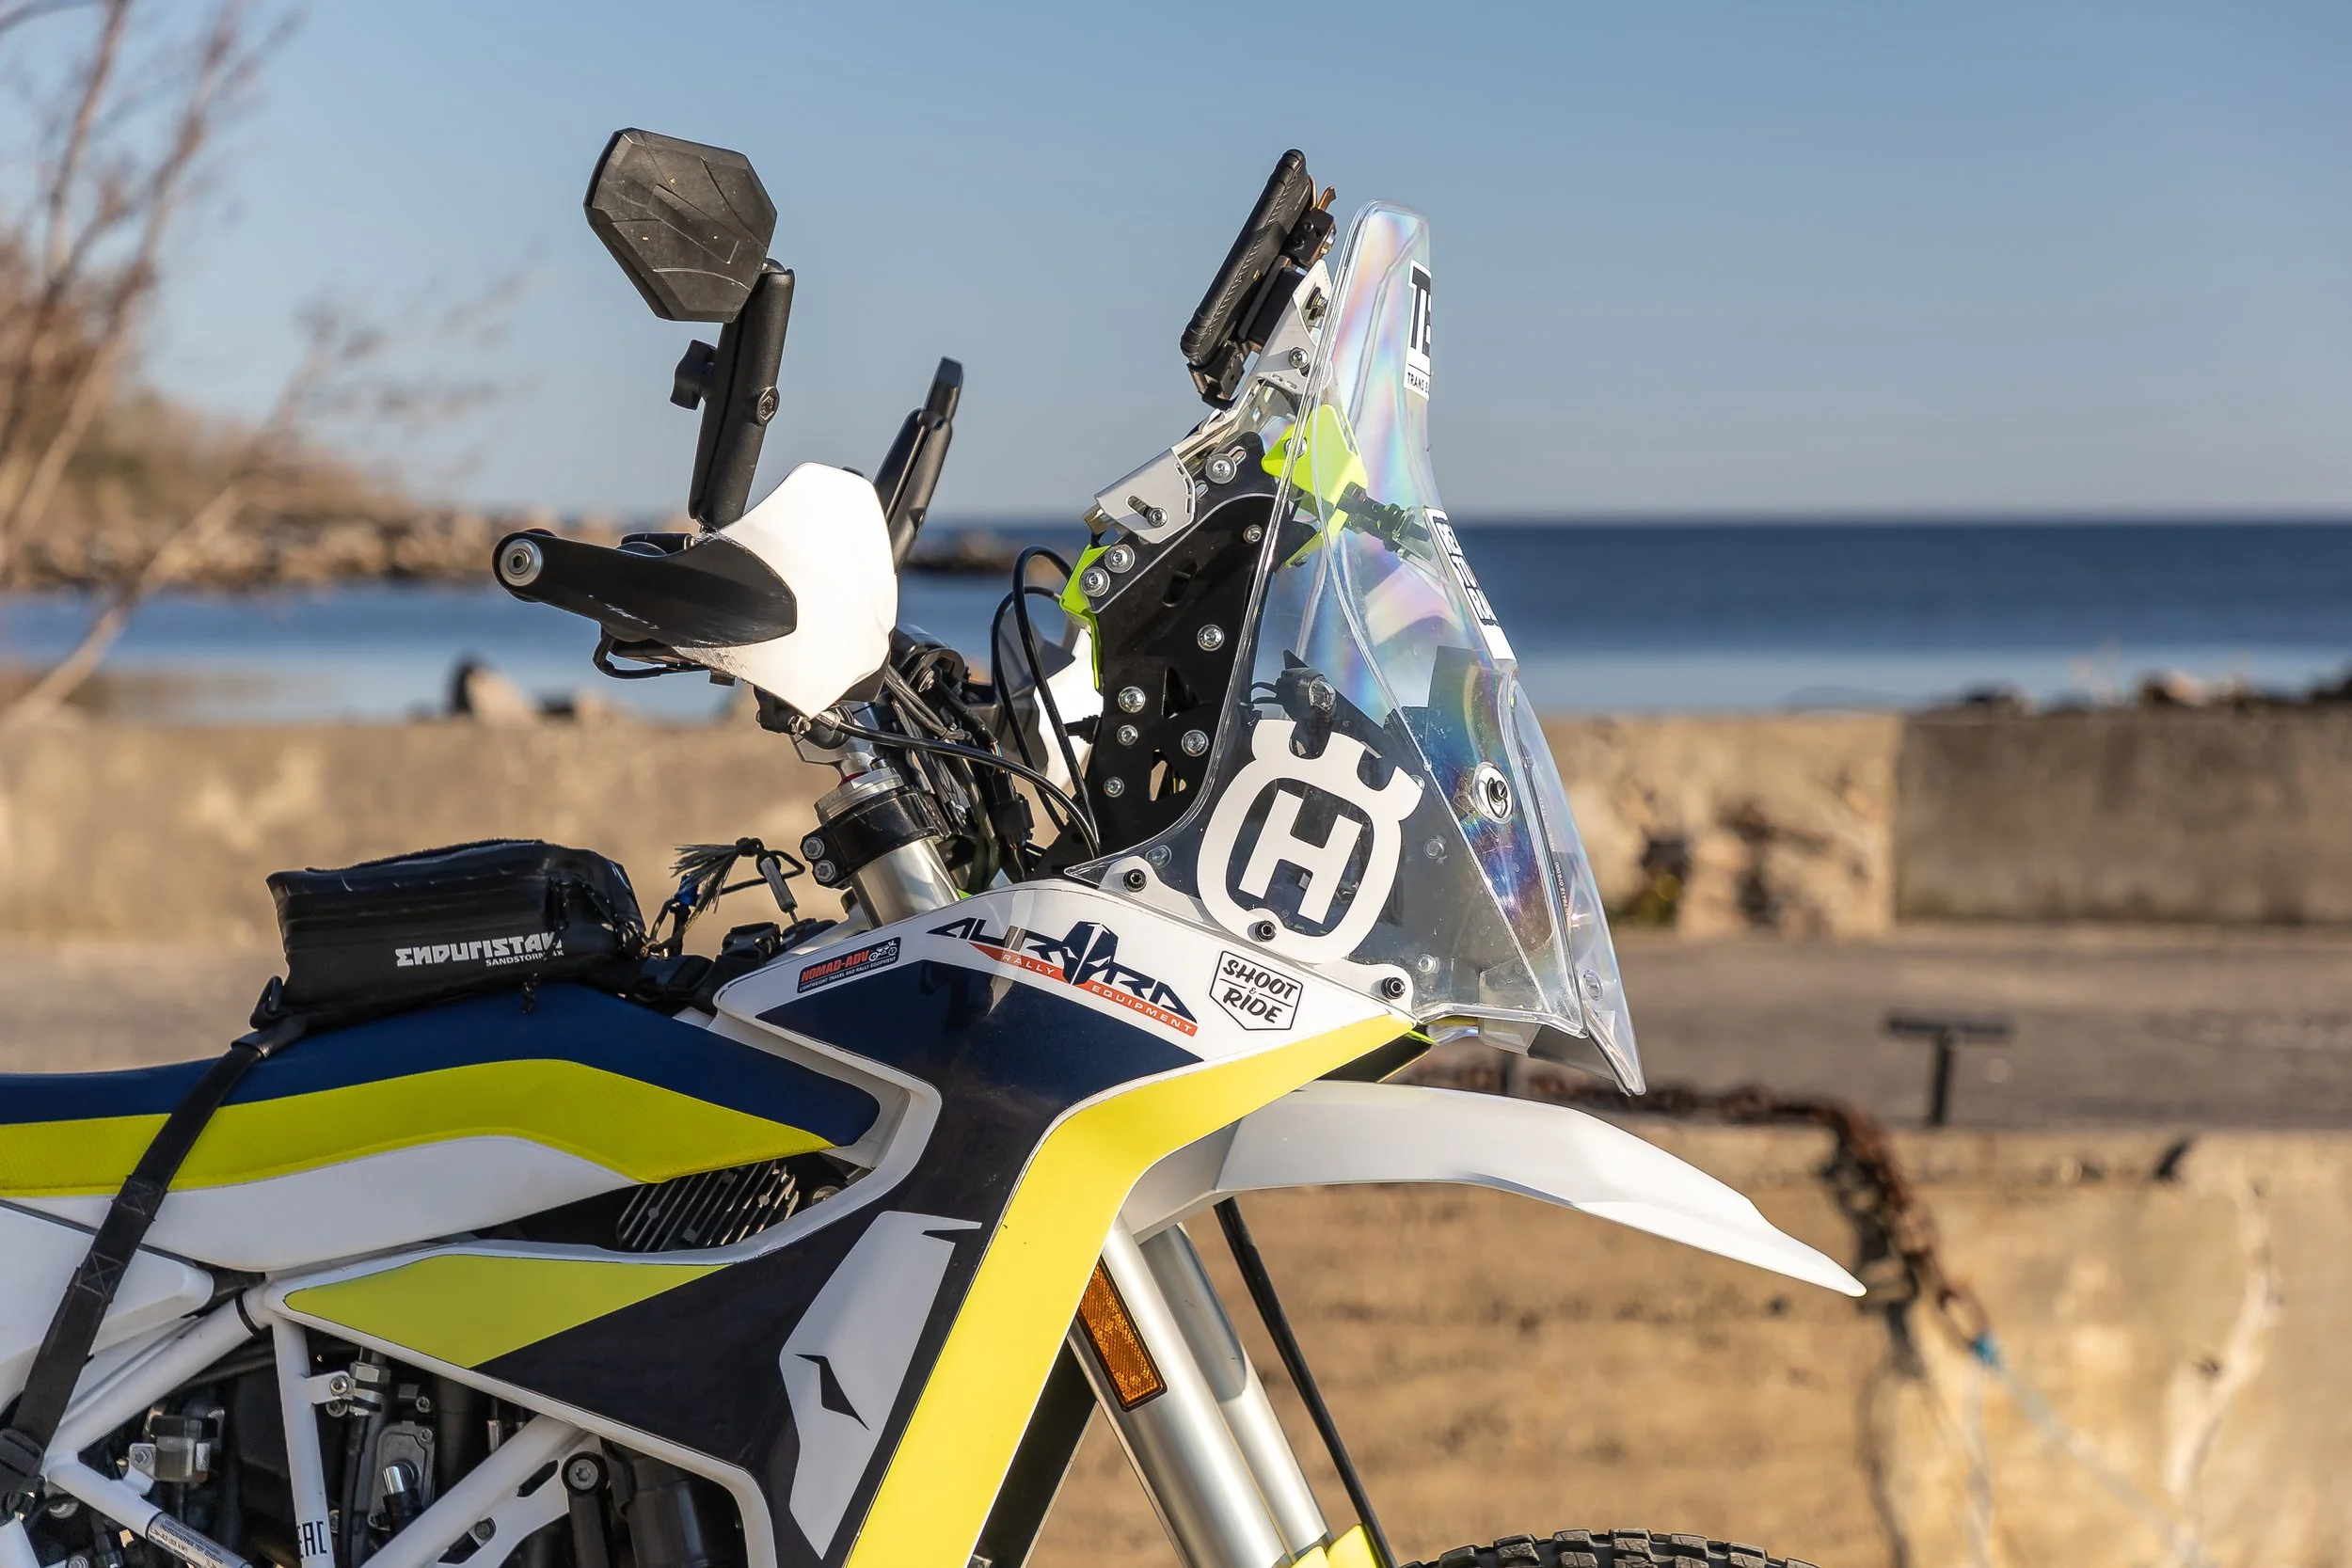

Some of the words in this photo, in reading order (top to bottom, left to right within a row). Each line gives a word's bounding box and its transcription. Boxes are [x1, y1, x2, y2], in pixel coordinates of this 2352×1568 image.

[1407, 372, 1424, 391] TRANS
[1238, 788, 1363, 925] H
[799, 977, 828, 991] LIGHTWEIGHT
[828, 973, 845, 982] TRAVEL
[845, 968, 855, 976] AND
[855, 964, 869, 973] RALLY
[869, 956, 897, 969] EQUIPMENT
[801, 949, 870, 982] NOMAD-ADV
[1222, 959, 1298, 1000] SHOOT
[1002, 954, 1055, 975] RALLY
[1091, 985, 1192, 1033] EQUIPMENT
[1222, 987, 1283, 1024] RIDE
[1248, 987, 1258, 995] &
